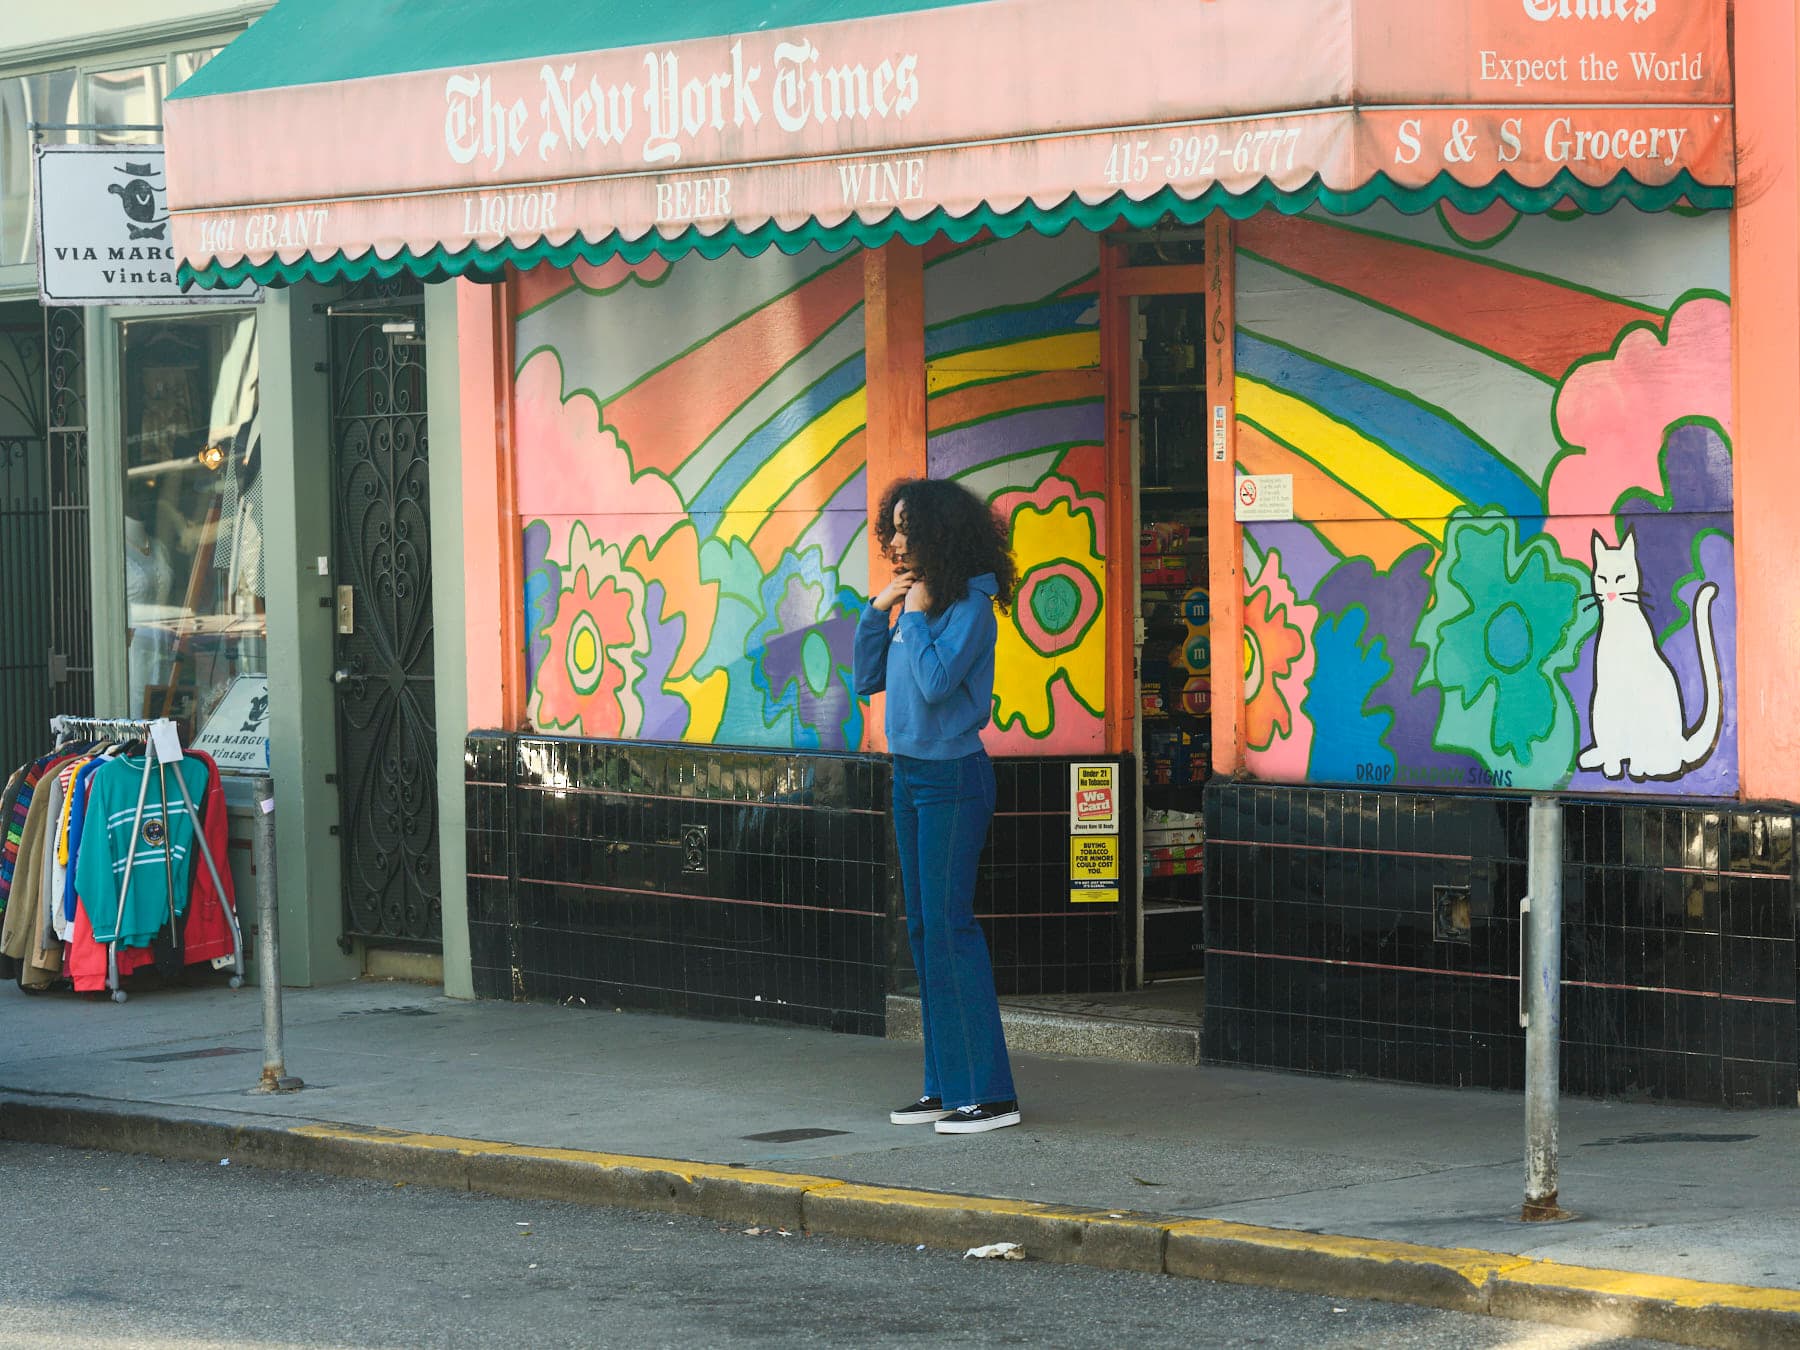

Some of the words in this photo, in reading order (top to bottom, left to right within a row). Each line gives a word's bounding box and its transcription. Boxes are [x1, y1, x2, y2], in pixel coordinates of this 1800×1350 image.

[1480, 50, 1568, 87] Expect
[1580, 52, 1619, 81] the
[1629, 52, 1703, 81] World
[445, 71, 529, 173] The
[538, 62, 636, 163] New
[642, 38, 764, 164] York
[772, 37, 918, 132] Times
[1394, 118, 1422, 165] S
[1443, 117, 1477, 164] &
[1497, 117, 1523, 163] S
[1543, 116, 1687, 167] Grocery
[199, 218, 236, 252] 1461
[245, 209, 329, 250] GRANT
[462, 191, 558, 238] LIQUOR
[655, 177, 732, 223] BEER
[838, 158, 924, 206] WINE
[1103, 127, 1303, 185] 415-392-6777
[54, 247, 98, 261] VIA
[101, 267, 179, 285] Vinta
[1192, 604, 1205, 617] m
[1193, 647, 1206, 660] m
[201, 734, 221, 744] VIA
[212, 748, 256, 761] Vintage
[1082, 770, 1099, 778] Under
[1355, 762, 1392, 782] DROP
[1400, 764, 1465, 785] SHADOW
[1467, 767, 1514, 788] SIGNS
[1082, 791, 1105, 802] We
[1078, 799, 1111, 813] Card
